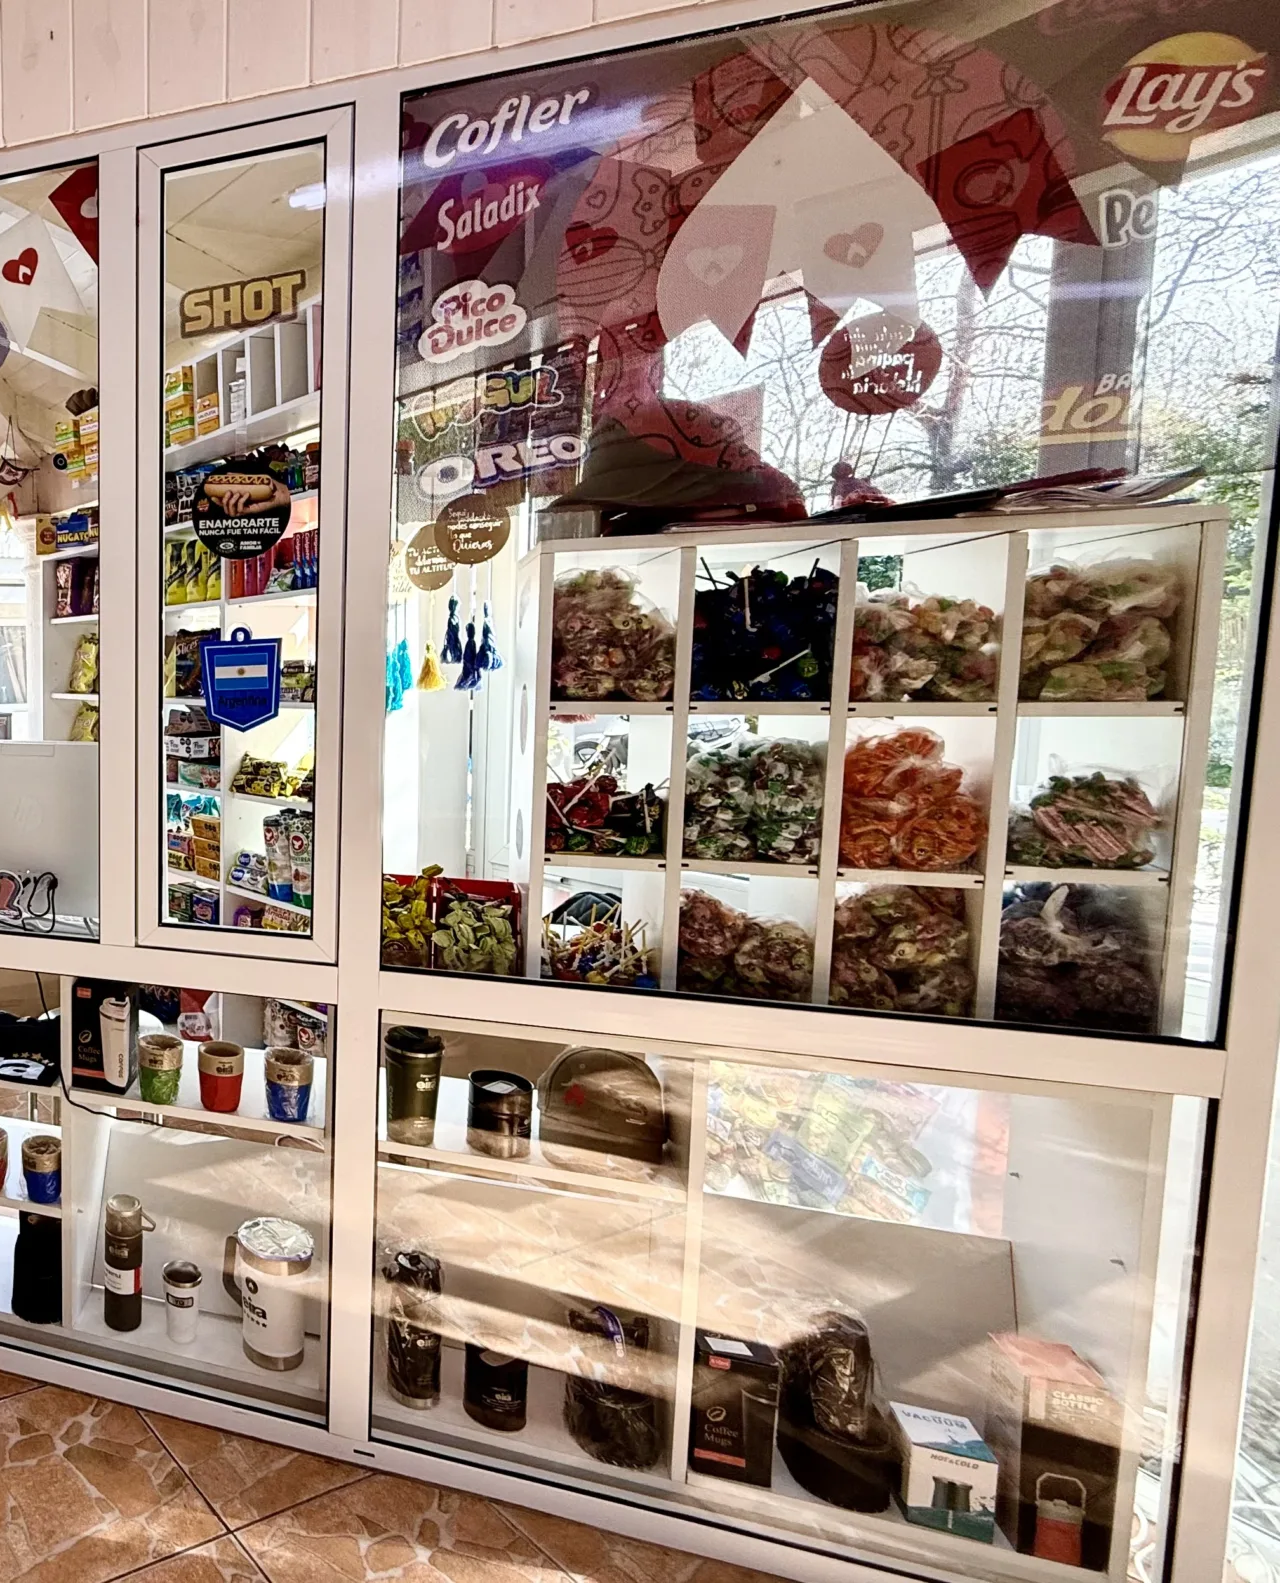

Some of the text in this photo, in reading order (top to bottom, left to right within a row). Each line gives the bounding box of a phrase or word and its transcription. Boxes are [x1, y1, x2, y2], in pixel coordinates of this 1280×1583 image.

[1102, 60, 1266, 134] Lay's
[423, 87, 591, 168] Cofler
[436, 181, 541, 251] Saladix
[182, 273, 303, 333] SHOT
[439, 291, 507, 325] Pico
[427, 312, 517, 356] Dulce
[418, 434, 588, 498] OREO
[198, 517, 280, 529] ENAMORARTE
[226, 528, 242, 536] FUE
[259, 526, 281, 535] FÁCIL
[1052, 1390, 1105, 1406] CLASSIC
[1052, 1398, 1099, 1413] BOTTLE
[704, 1423, 739, 1438] Coffee
